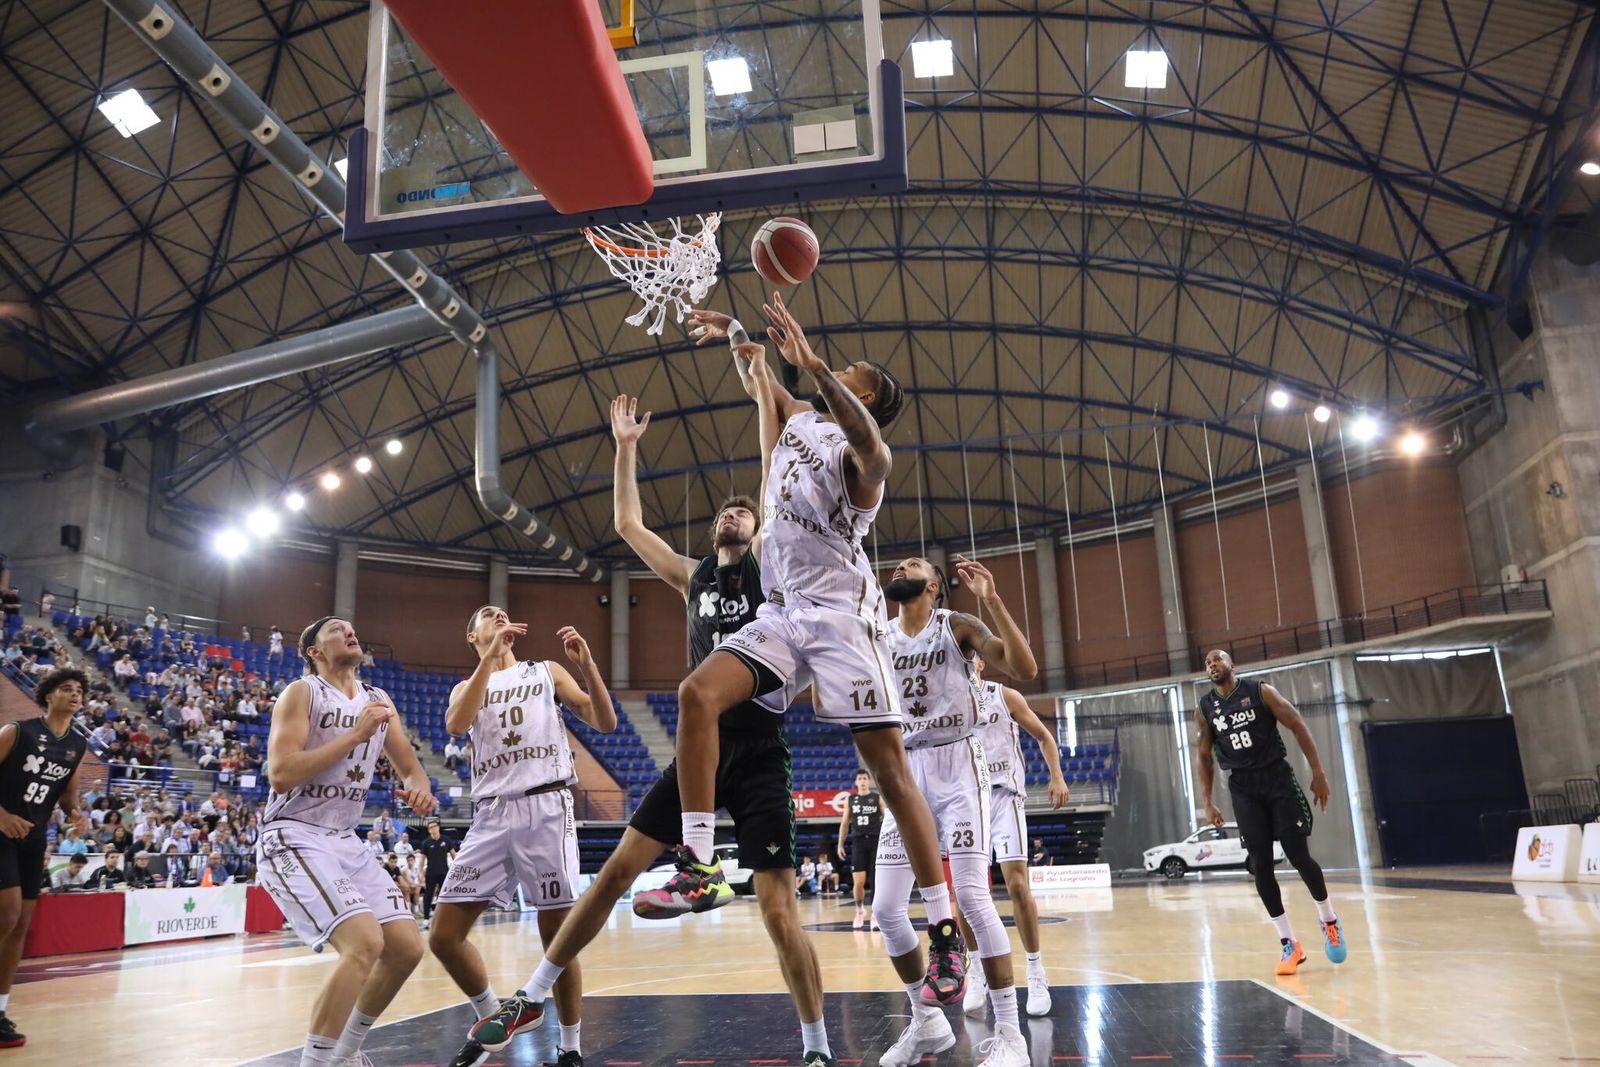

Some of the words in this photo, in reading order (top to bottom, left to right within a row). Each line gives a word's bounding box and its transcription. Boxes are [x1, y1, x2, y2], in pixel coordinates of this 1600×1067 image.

[890, 650, 946, 672] lavijo
[852, 679, 873, 687] vive
[902, 675, 928, 698] 23
[480, 682, 544, 709] lavijo
[849, 689, 878, 711] 14
[499, 706, 524, 729] 10
[901, 714, 964, 735] OVERDE
[1229, 730, 1253, 750] 28
[23, 781, 50, 805] 93
[857, 815, 870, 826] 23
[952, 829, 975, 848] 23
[1002, 841, 1009, 854] 1
[541, 871, 557, 879] vive
[453, 886, 477, 894] RIOJA
[541, 880, 560, 900] 10
[157, 915, 219, 935] RIOVERDE
